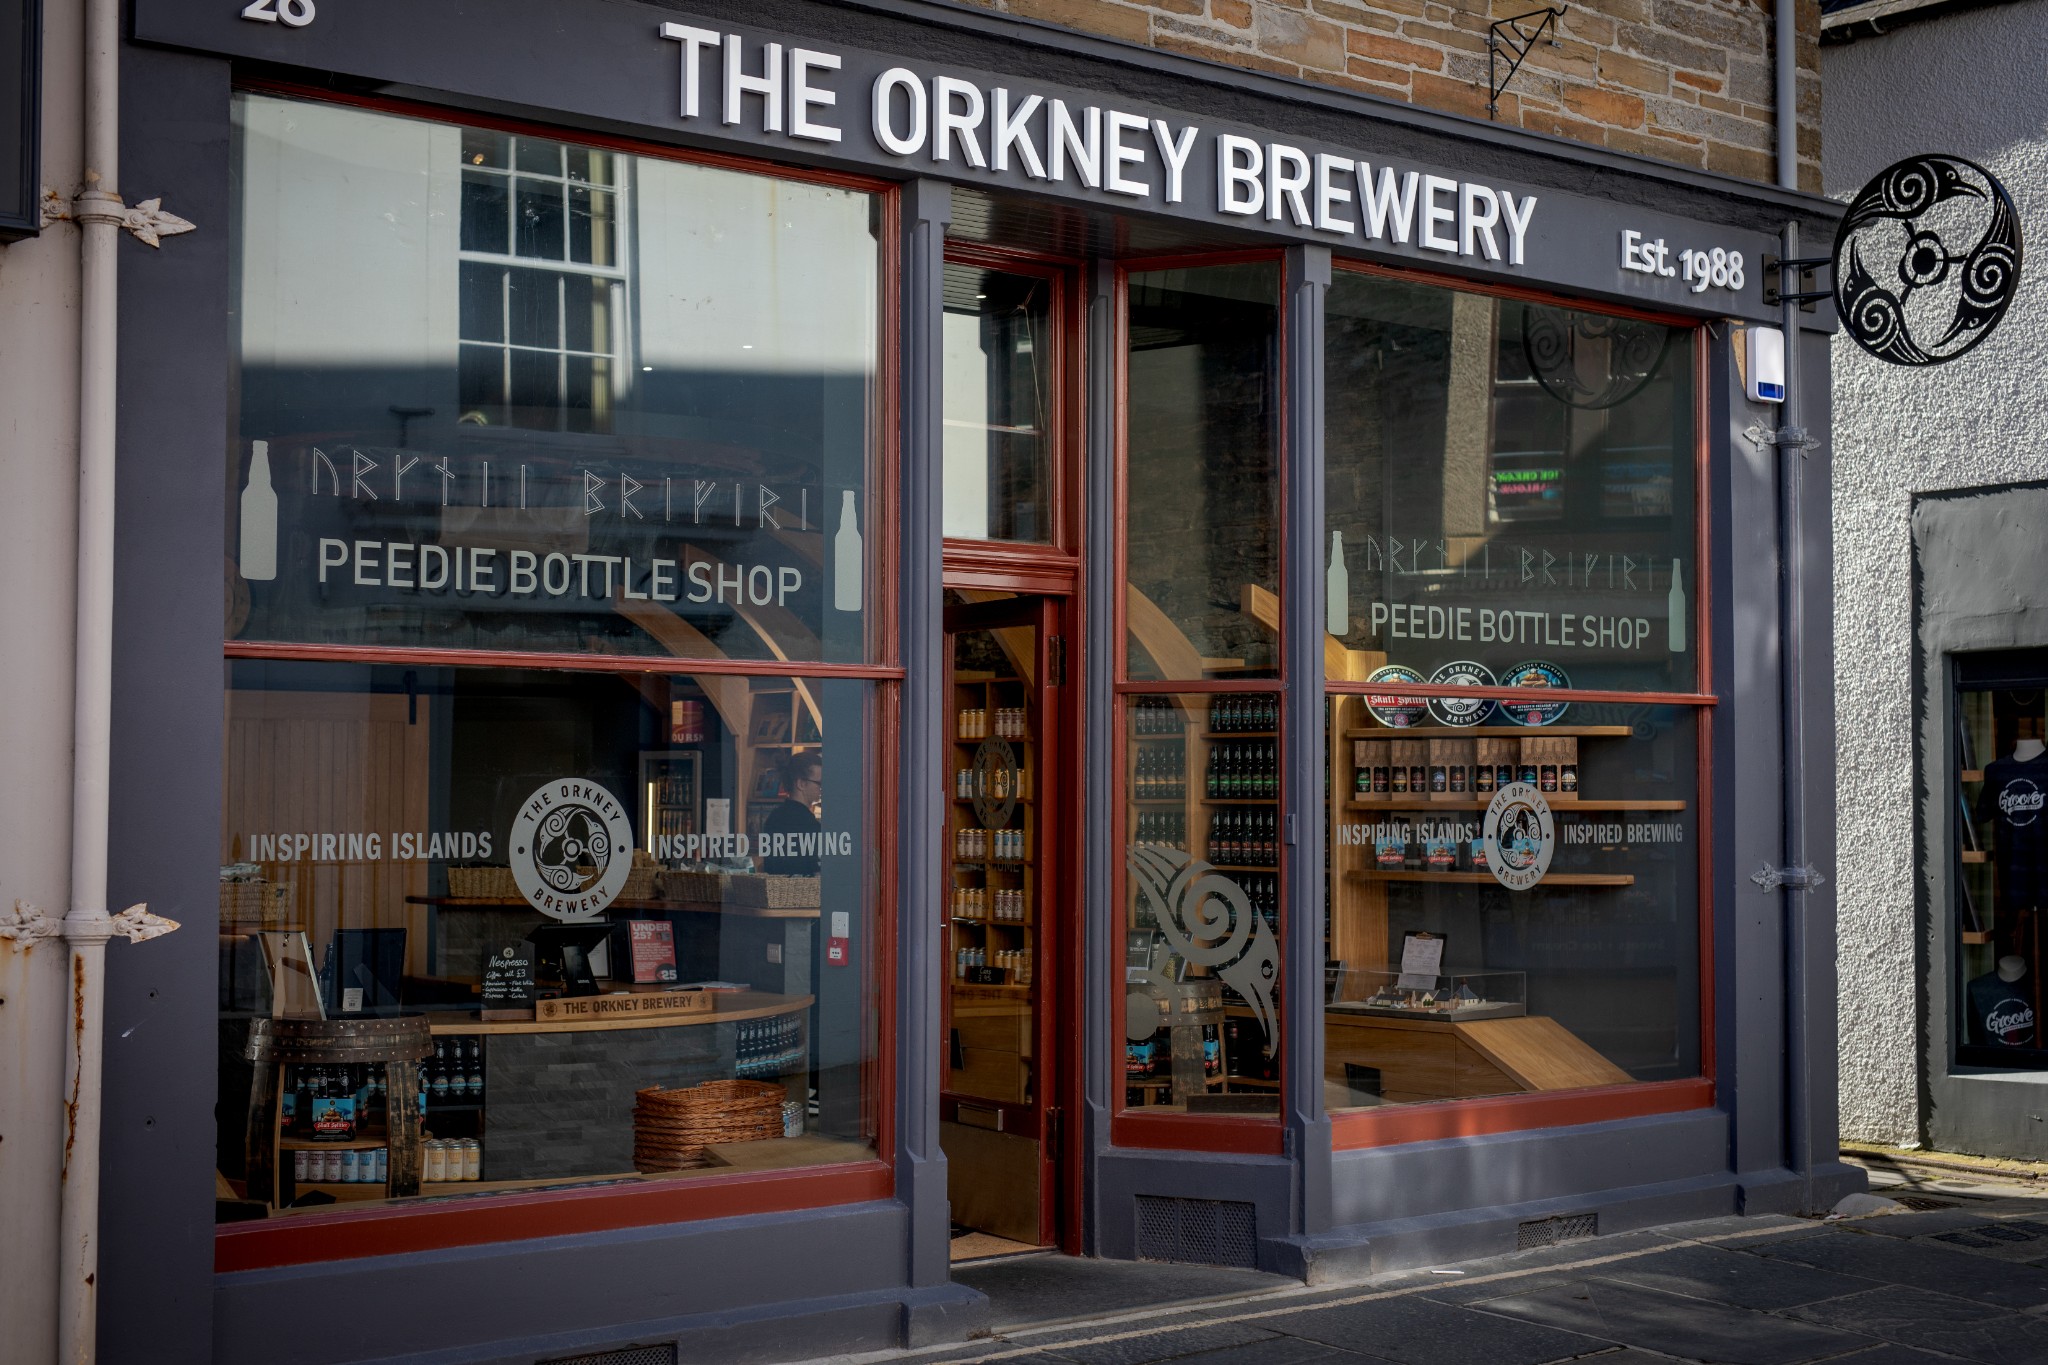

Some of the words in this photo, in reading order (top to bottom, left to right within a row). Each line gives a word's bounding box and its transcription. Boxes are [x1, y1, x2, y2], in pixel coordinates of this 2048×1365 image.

[659, 21, 842, 143] THE
[872, 67, 1199, 203] ORKNEY
[1216, 133, 1538, 266] BREWERY
[1621, 229, 1676, 278] Est.
[1678, 246, 1745, 293] 1988
[319, 537, 496, 592] PEEDIE
[510, 550, 676, 600] BOTTLE
[687, 561, 802, 607] SHOP
[1371, 602, 1472, 641] PEEDIE
[1479, 609, 1576, 647] BOTTLE
[1582, 614, 1651, 650] SHOP
[1449, 664, 1487, 678] ORKNEY
[1397, 696, 1427, 706] Splitte
[1446, 705, 1489, 724] BREWERY
[523, 792, 553, 823] THE
[561, 784, 622, 823] ORKNEY
[1490, 793, 1508, 816] THE
[1511, 787, 1547, 816] ORKNEY
[1336, 823, 1411, 846] INSPIRING
[1415, 823, 1474, 845] ISLANDS
[1563, 823, 1623, 845] INSPIRED
[1626, 823, 1683, 844] BREWING
[249, 832, 382, 862] INSPIRING
[392, 831, 493, 859] ISLANDS
[650, 832, 750, 860] INSPIRED
[758, 831, 852, 858] BREWING
[1497, 865, 1542, 886] BREWERY
[533, 885, 610, 914] BREWERY
[632, 923, 671, 932] UNDER
[633, 931, 652, 940] 25?
[488, 955, 529, 970] Nespresso
[516, 969, 527, 978] £3
[661, 969, 678, 981] 25
[564, 1002, 588, 1014] THE
[592, 999, 640, 1013] ORKNEY
[642, 996, 692, 1010] BREWERY
